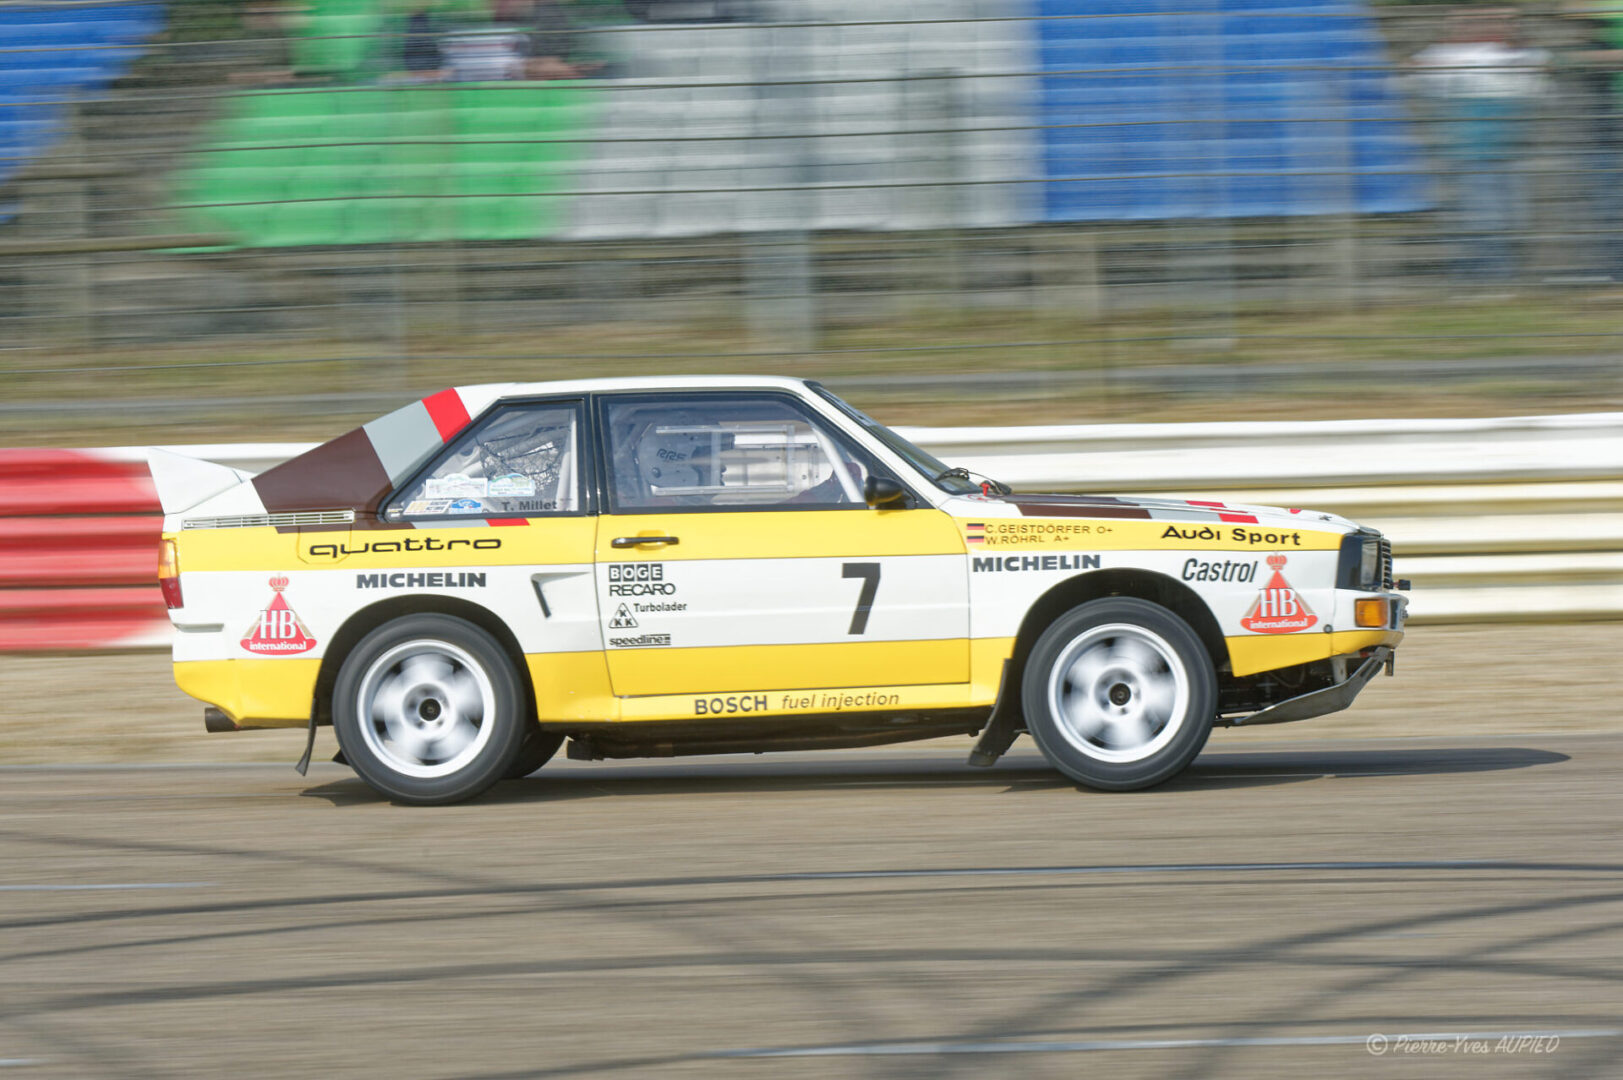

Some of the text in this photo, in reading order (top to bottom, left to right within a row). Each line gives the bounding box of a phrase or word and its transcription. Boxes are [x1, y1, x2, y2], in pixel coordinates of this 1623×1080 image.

[519, 500, 557, 510] Millet
[1161, 526, 1301, 546] Audi Sport
[309, 537, 501, 558] quattro
[972, 555, 1100, 572] MICHELIN
[1182, 558, 1258, 583] Castrol
[356, 572, 486, 589] MICHELIN
[609, 564, 663, 582] BOGE
[609, 583, 676, 597] RECARO
[841, 562, 881, 635] 7
[633, 602, 687, 612] Turbolader
[1259, 588, 1297, 617] HB
[260, 609, 297, 639] HB
[1250, 618, 1308, 629] international
[249, 640, 307, 651] international
[609, 634, 664, 646] speedline
[695, 695, 768, 715] BOSCH
[782, 692, 900, 710] fuel injection
